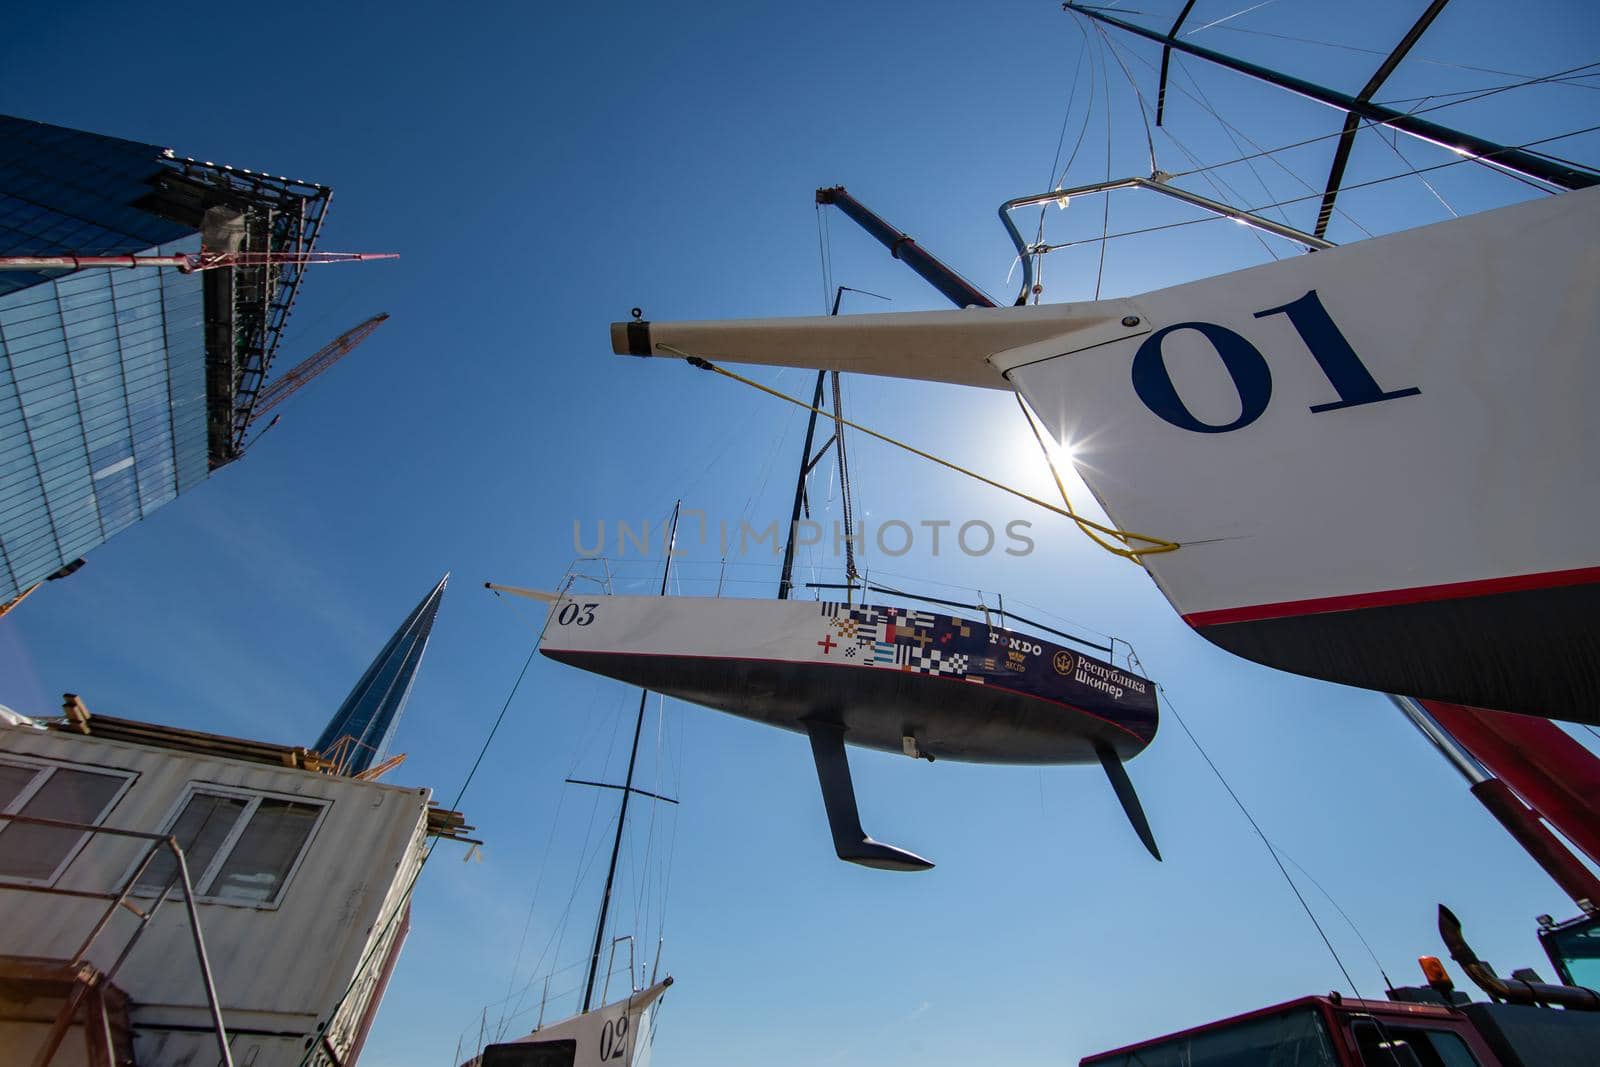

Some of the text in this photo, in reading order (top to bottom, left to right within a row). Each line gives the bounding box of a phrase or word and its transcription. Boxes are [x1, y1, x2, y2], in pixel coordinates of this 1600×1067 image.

[1131, 289, 1422, 434] 01
[558, 603, 599, 626] 03
[989, 632, 1042, 656] TONDO
[1075, 669, 1123, 699] Шкипер
[1076, 656, 1145, 694] Республика
[600, 1016, 628, 1062] 02
